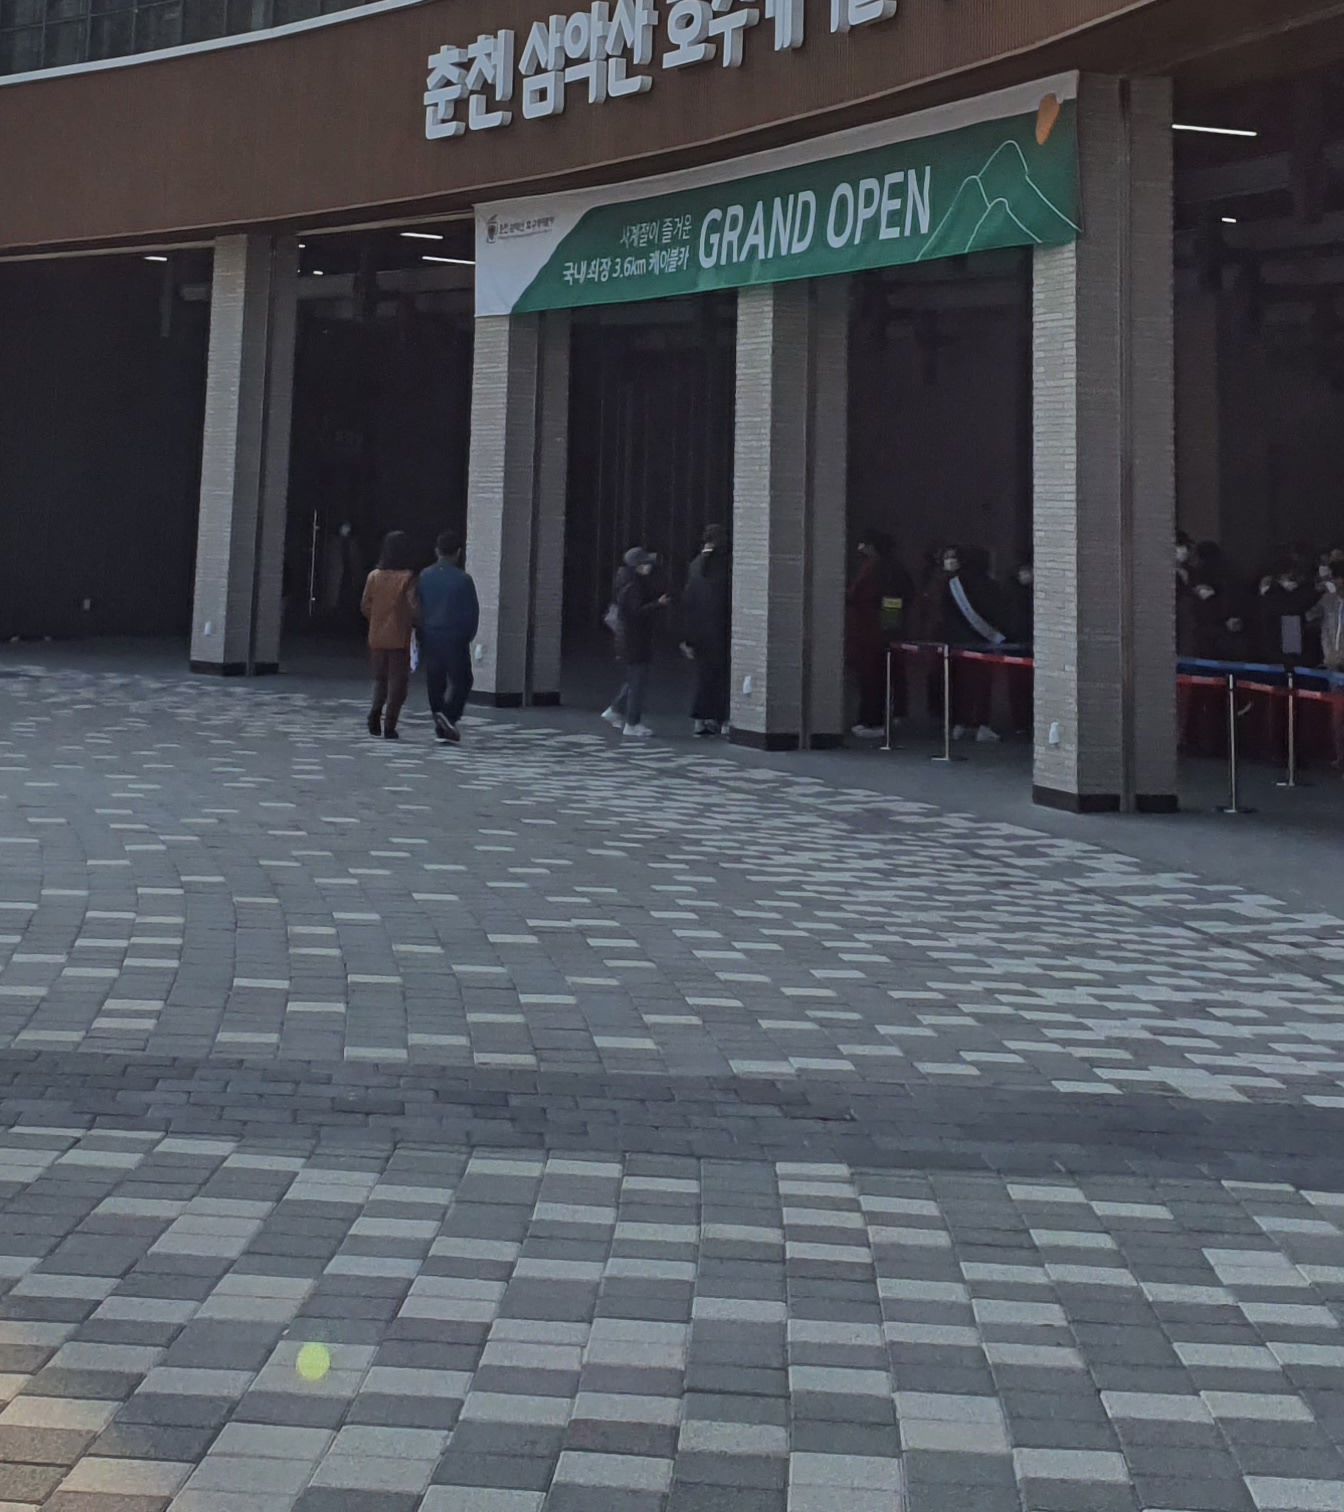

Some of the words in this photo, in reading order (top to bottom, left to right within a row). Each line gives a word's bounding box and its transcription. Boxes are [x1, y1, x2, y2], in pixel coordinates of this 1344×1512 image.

[423, 29, 514, 140] 춘천
[620, 220, 660, 249] 사계절이
[661, 214, 692, 243] 즐거운
[698, 189, 816, 268] GRAND
[826, 165, 931, 249] OPEN
[612, 256, 647, 278] 3.6km
[649, 245, 690, 275] 케이블카
